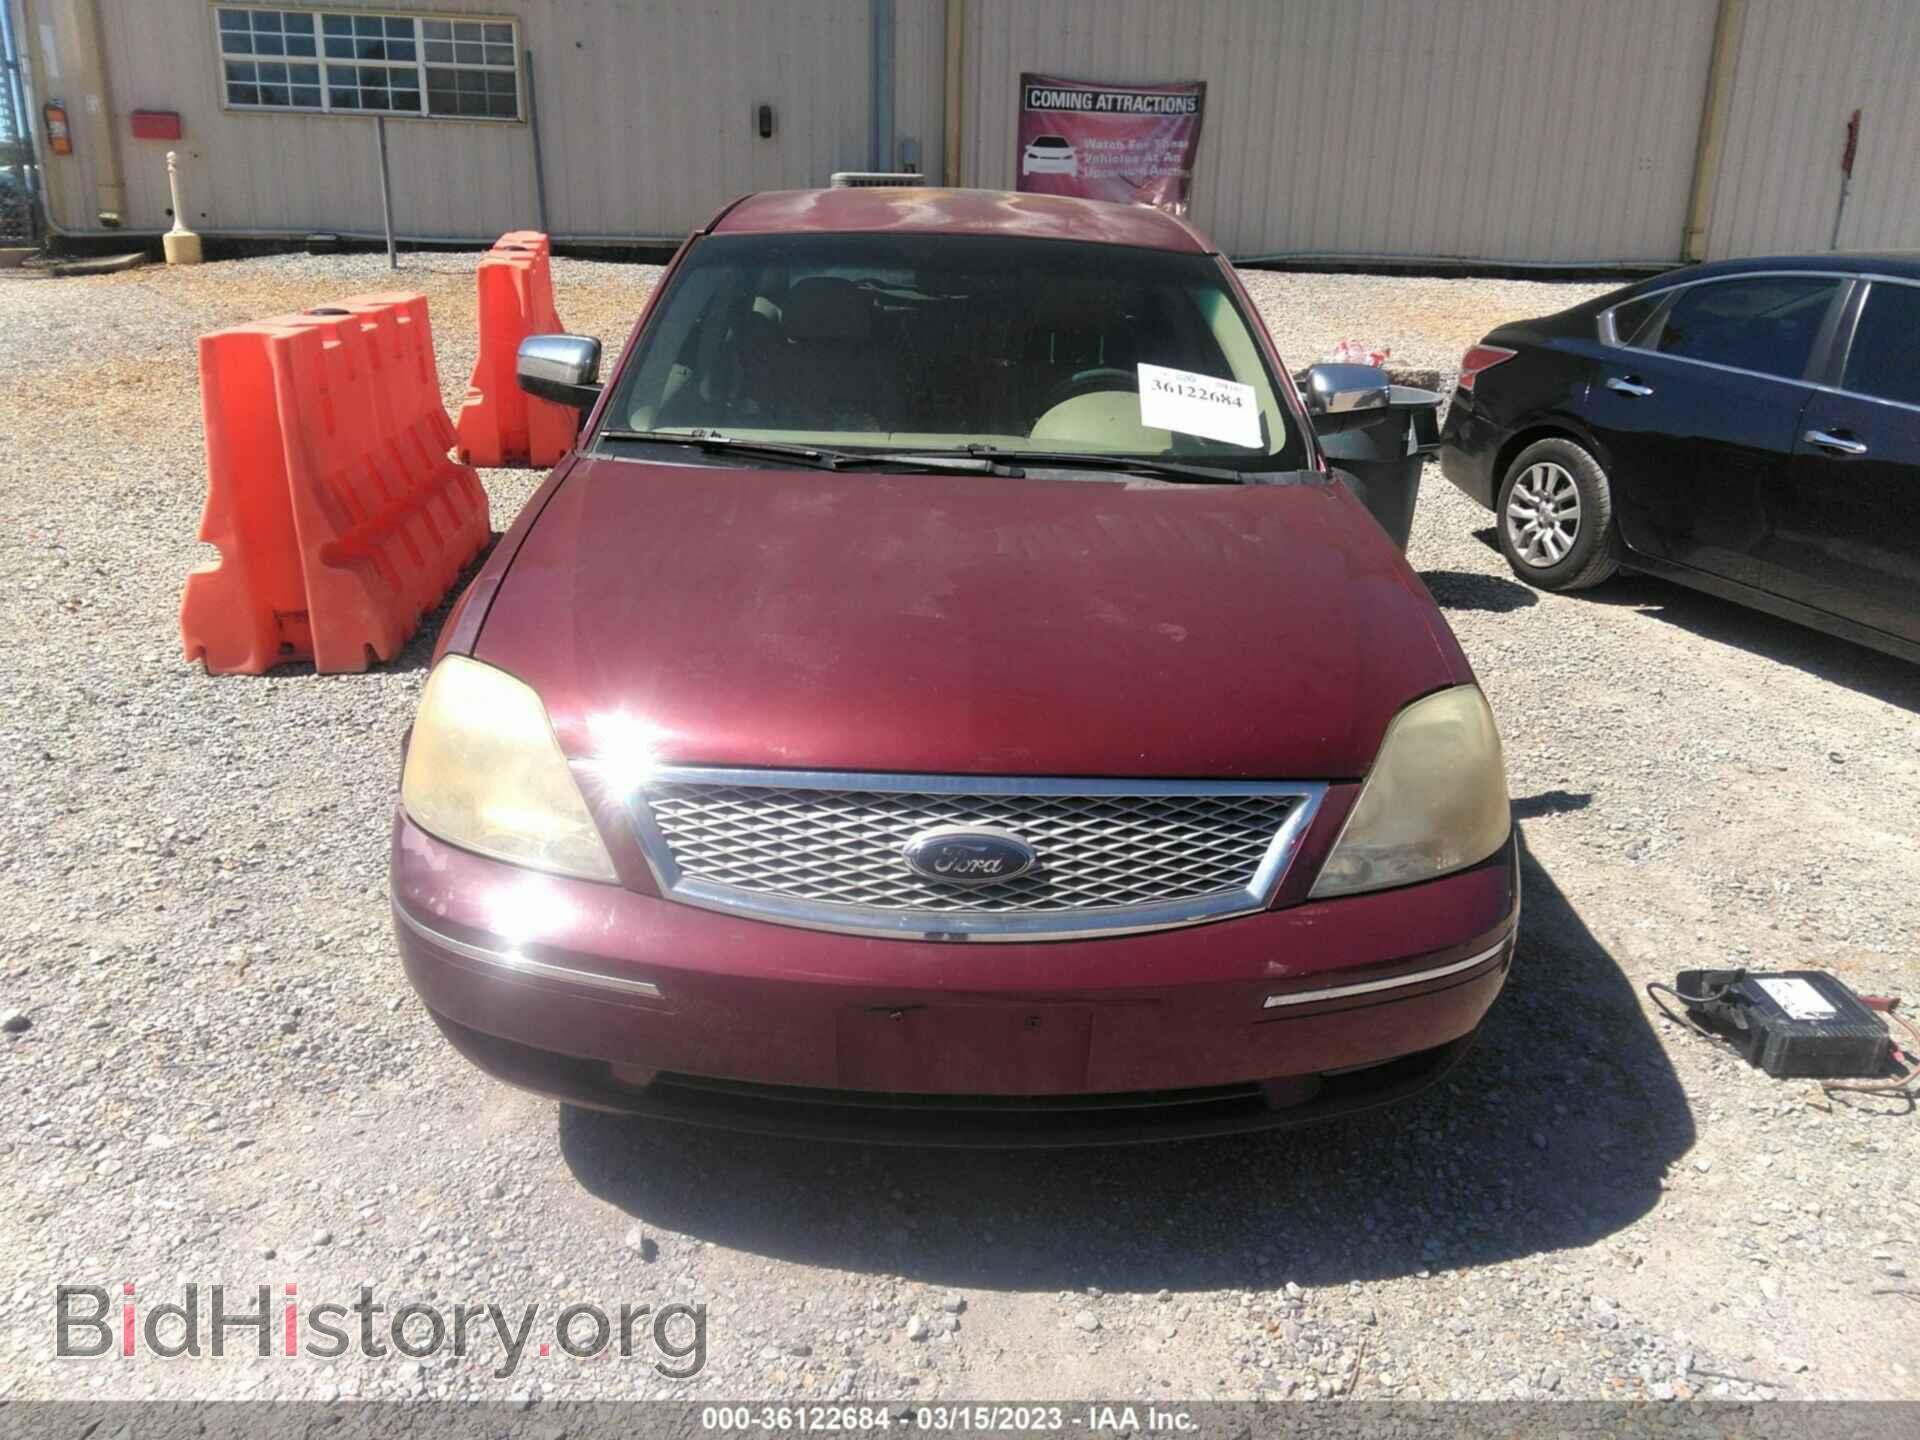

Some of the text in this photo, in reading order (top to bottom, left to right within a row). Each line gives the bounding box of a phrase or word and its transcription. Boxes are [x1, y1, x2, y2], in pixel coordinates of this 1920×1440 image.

[1031, 90, 1196, 113] COMING ATTRACTIONS
[1152, 379, 1243, 408] 36122684
